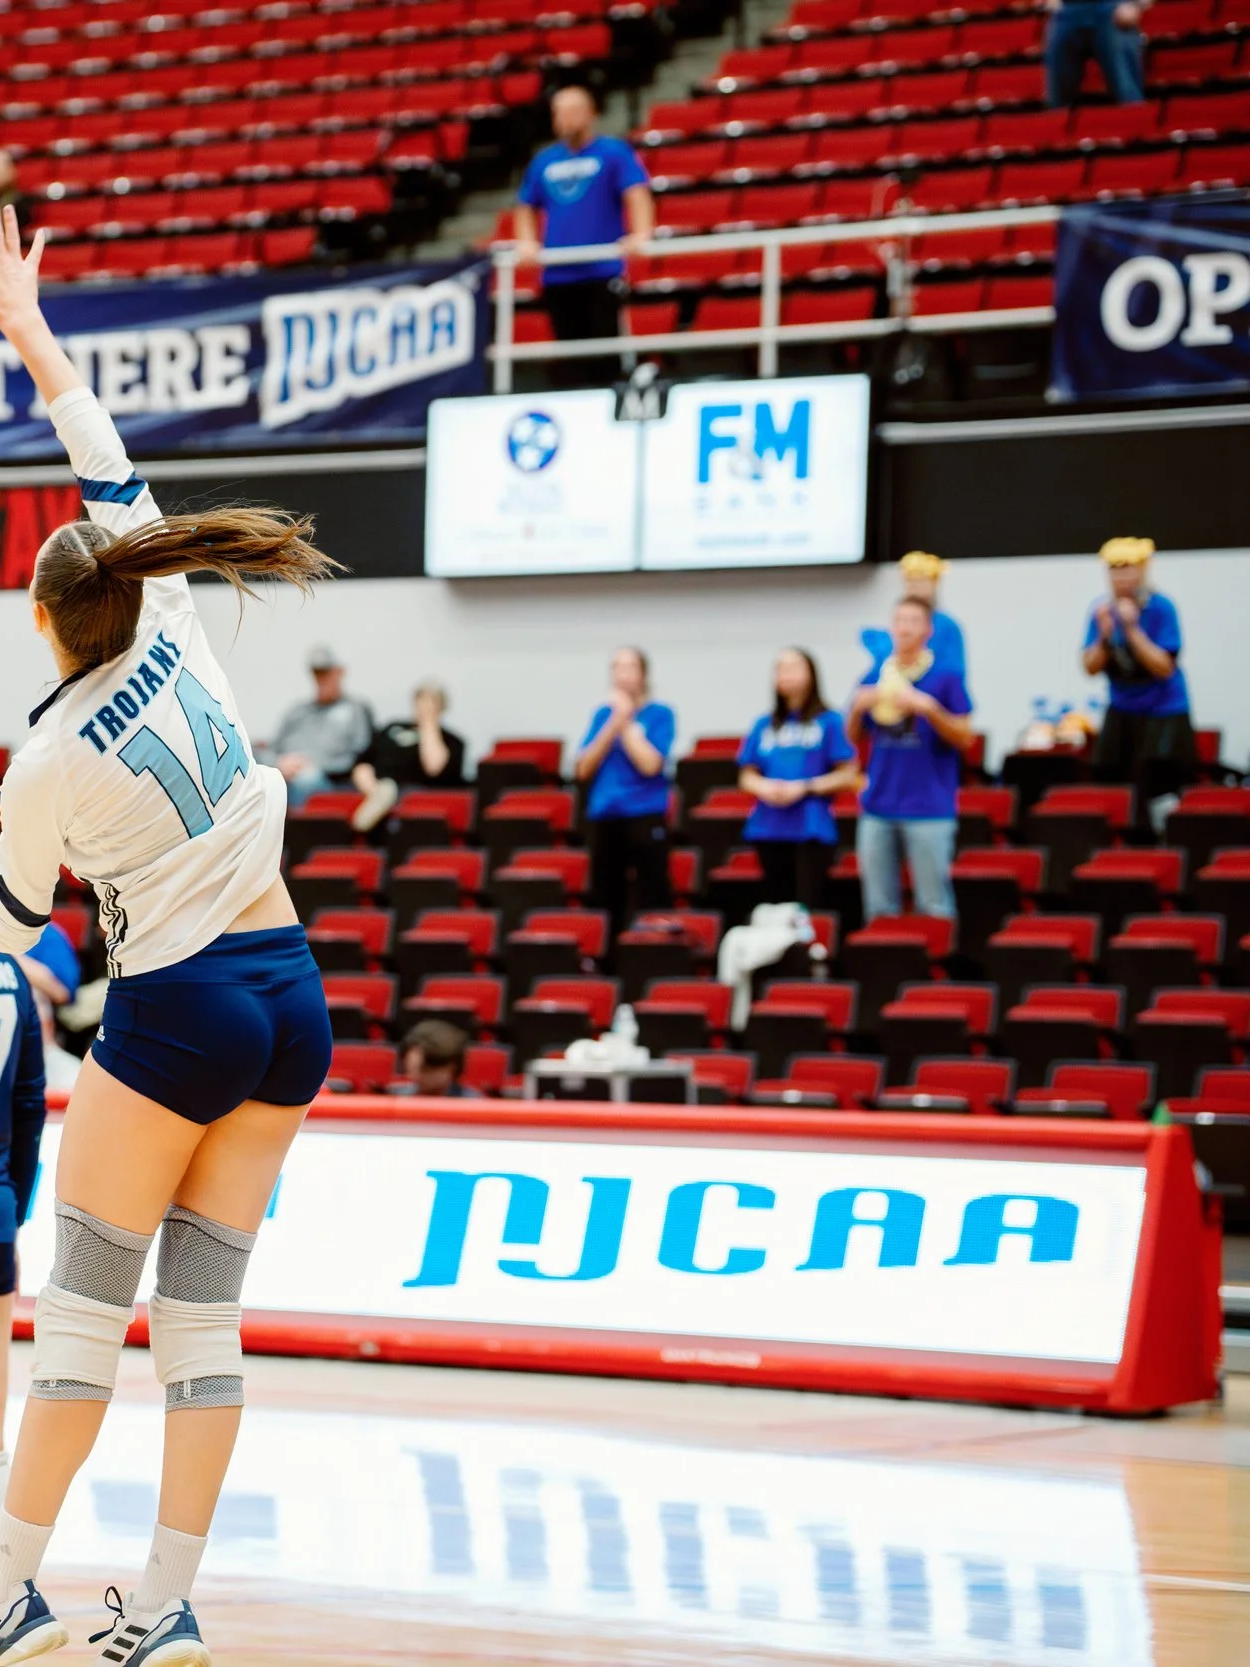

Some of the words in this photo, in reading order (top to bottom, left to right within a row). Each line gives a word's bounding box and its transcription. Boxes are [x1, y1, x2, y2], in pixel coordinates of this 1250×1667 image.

[273, 296, 460, 408] NJCAA
[78, 629, 182, 756] TROJANS
[116, 666, 250, 840] 14
[402, 1169, 1080, 1287] NJCAA
